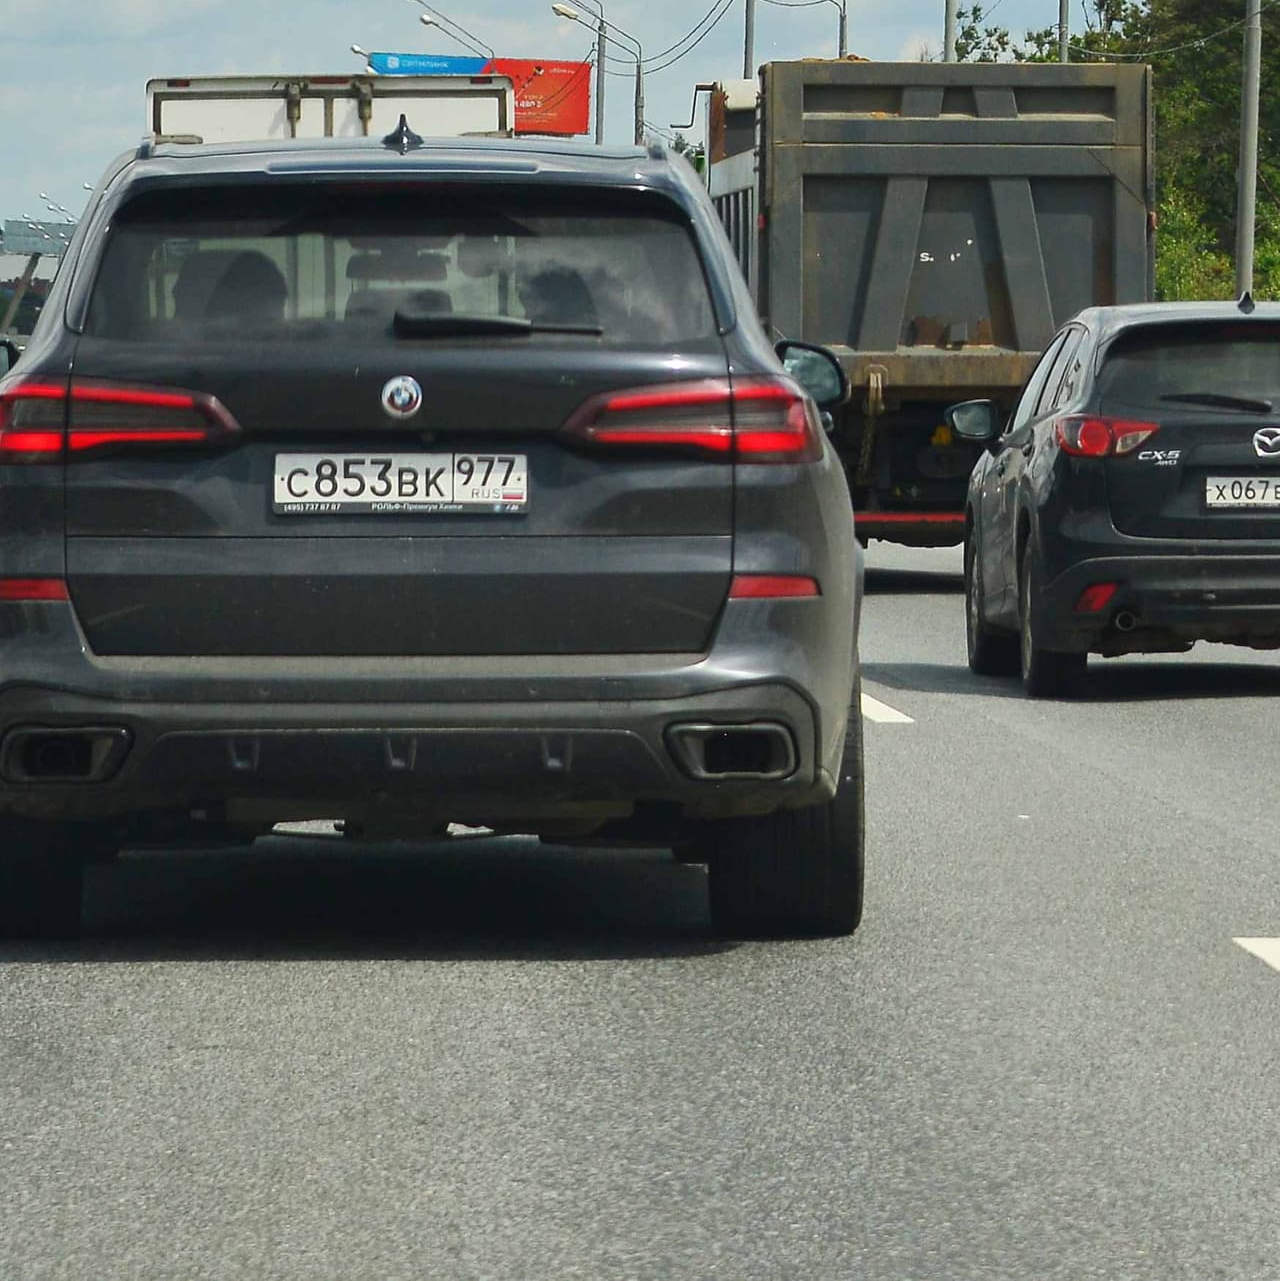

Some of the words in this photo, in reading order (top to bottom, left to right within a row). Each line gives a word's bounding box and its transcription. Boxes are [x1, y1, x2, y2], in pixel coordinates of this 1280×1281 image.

[1138, 449, 1182, 460] CX-5
[456, 456, 516, 487] 977
[471, 488, 501, 499] RUS
